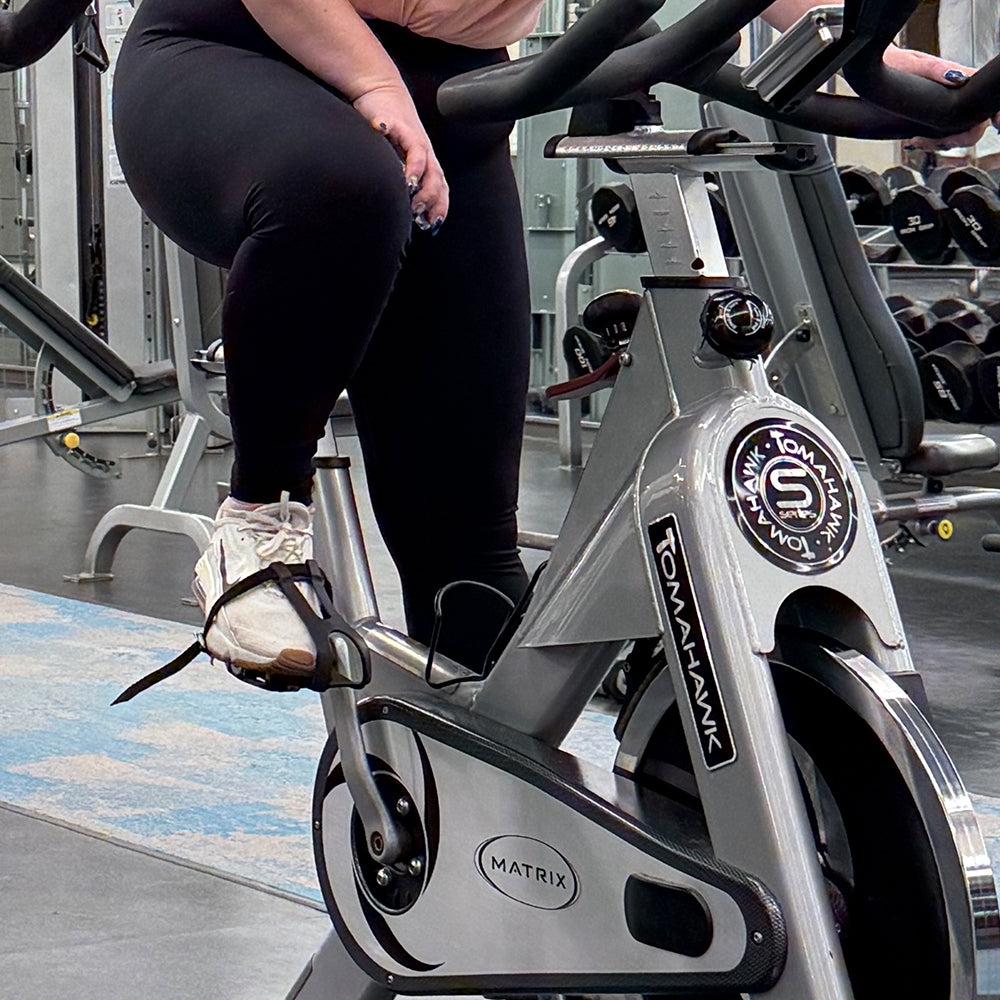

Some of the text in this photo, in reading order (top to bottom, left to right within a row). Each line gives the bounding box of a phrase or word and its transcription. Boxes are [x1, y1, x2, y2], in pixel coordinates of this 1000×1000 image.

[966, 214, 983, 232] 30
[742, 446, 816, 560] TOMAHAWK
[769, 430, 843, 544] TOMAHAWK
[770, 468, 813, 509] S
[778, 509, 817, 520] series
[656, 527, 722, 754] TOMAHAWK
[491, 855, 567, 890] MATRIX
